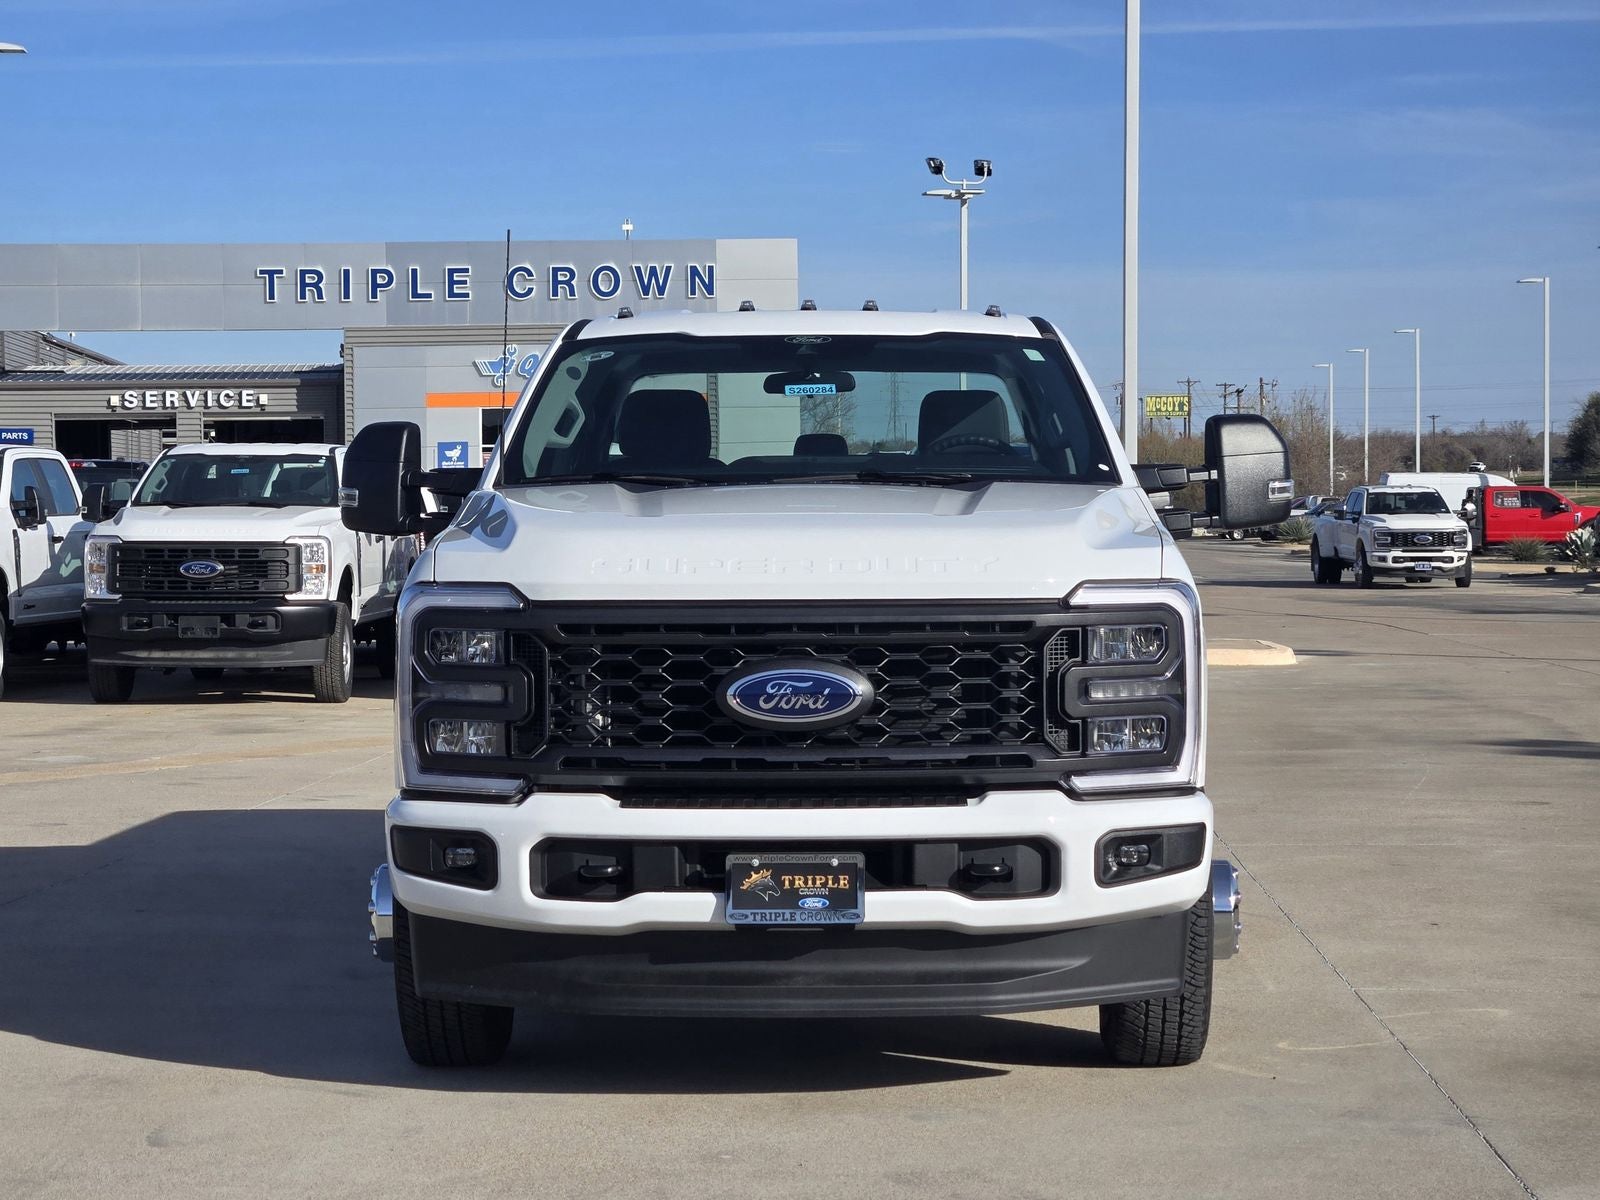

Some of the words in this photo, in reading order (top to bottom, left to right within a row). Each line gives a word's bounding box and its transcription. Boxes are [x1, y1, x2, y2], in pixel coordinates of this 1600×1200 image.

[257, 266, 472, 303] TRIPLE
[506, 264, 717, 300] CROWN
[788, 386, 833, 394] S260284
[123, 389, 255, 409] SERVICE
[1, 432, 29, 440] PARTS
[759, 680, 832, 710] Ford
[735, 854, 858, 863] wwwTripleCrownFordcom
[781, 875, 850, 889] TRIPLE
[750, 911, 797, 921] TRIPLE
[799, 911, 841, 921] CROWN
